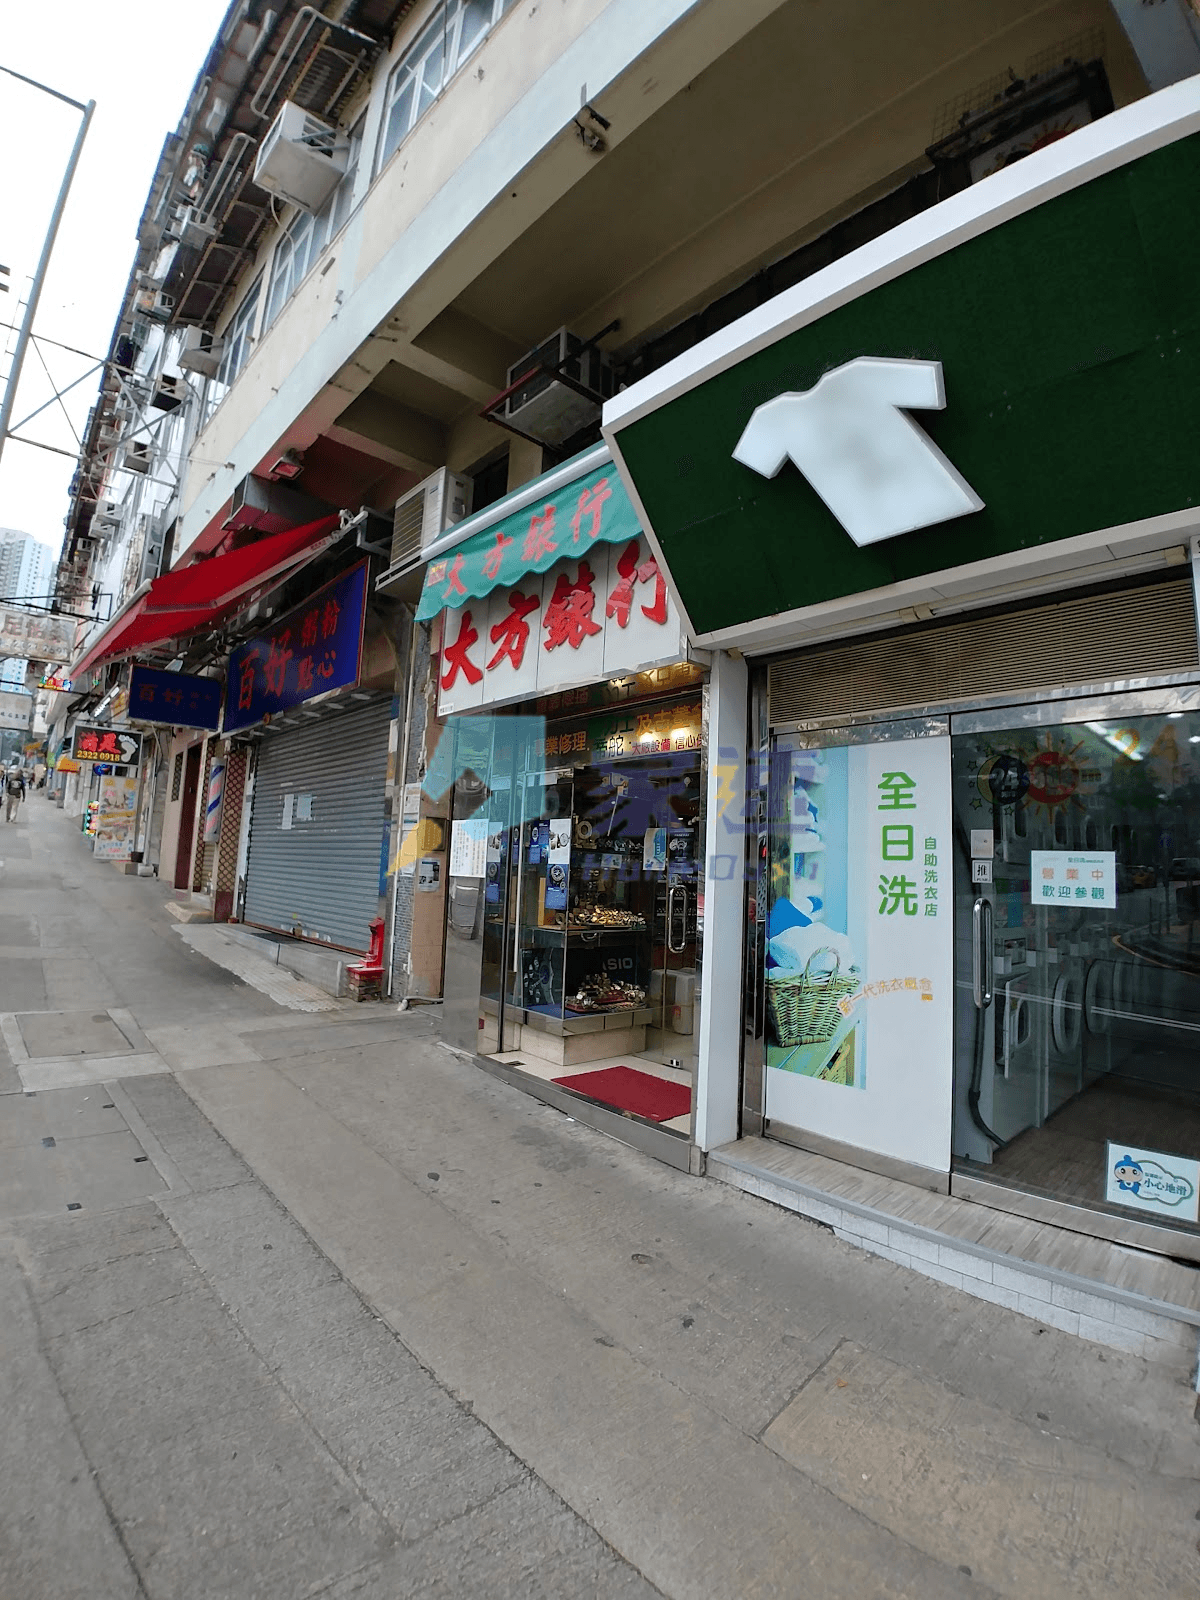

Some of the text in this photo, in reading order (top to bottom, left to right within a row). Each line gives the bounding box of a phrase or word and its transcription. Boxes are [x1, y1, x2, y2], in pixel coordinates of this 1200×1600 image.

[442, 477, 613, 599] 大方錶行
[440, 539, 668, 691] 大方錶行
[76, 750, 120, 761] 2322 0918
[877, 771, 918, 916] 全日洗
[924, 836, 938, 917] 自助洗衣店
[977, 864, 988, 877] 推
[1042, 867, 1104, 881] 營業中
[1042, 885, 1105, 900] 歡迎參觀
[1144, 1178, 1187, 1196] 小心地滑
